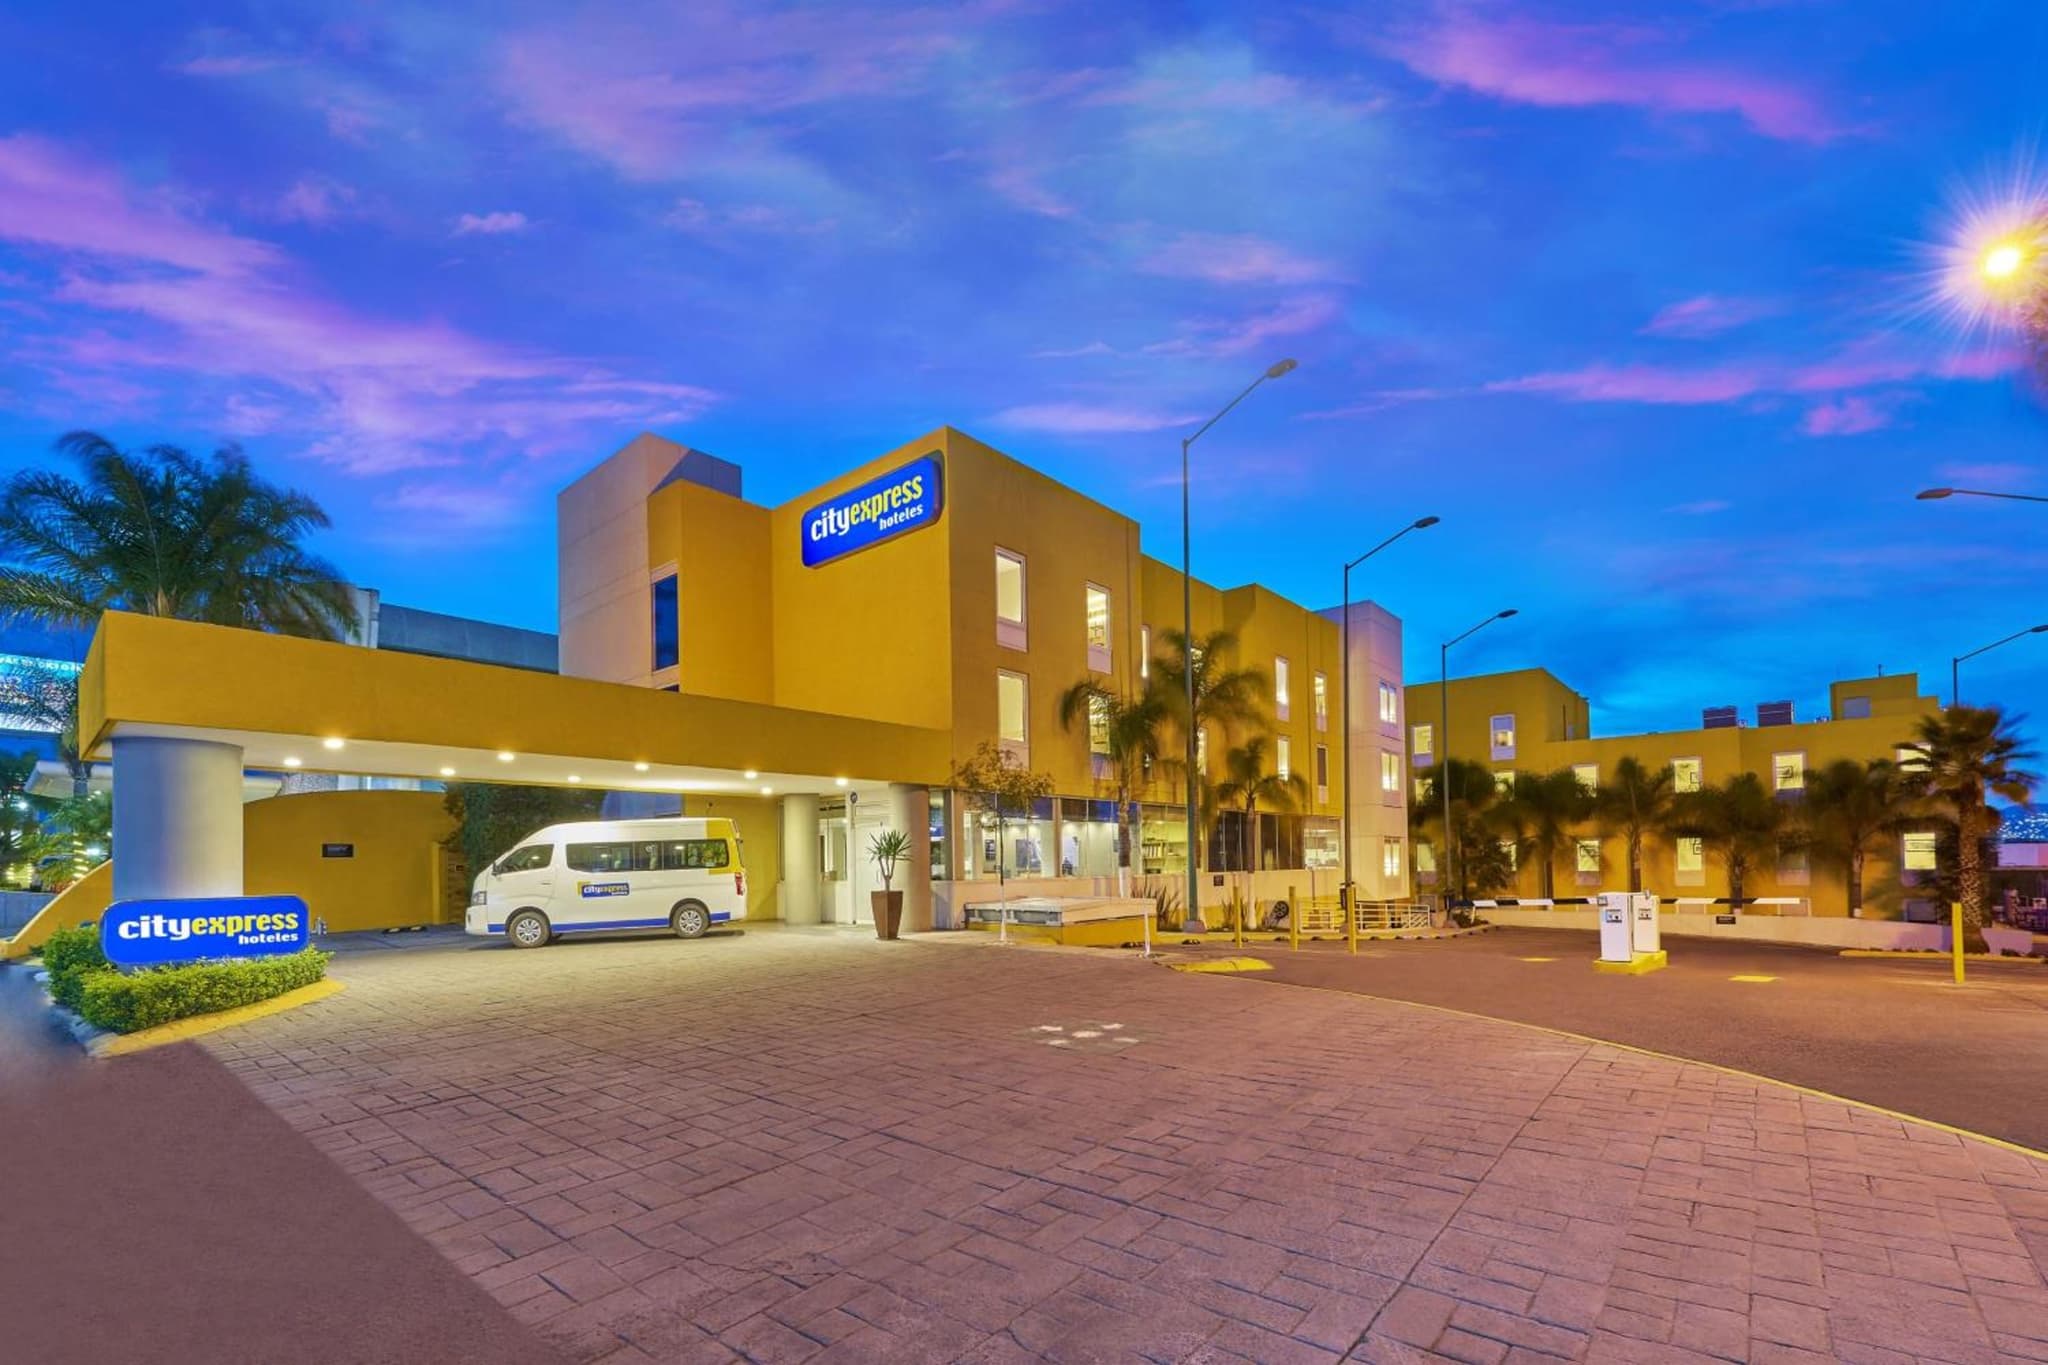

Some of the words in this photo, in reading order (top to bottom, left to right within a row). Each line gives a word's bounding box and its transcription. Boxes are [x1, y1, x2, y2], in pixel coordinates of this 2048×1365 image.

[811, 475, 923, 542] cityexpress
[879, 504, 923, 531] hoteles
[118, 913, 299, 941] cityexpress
[238, 932, 299, 945] hoteles
